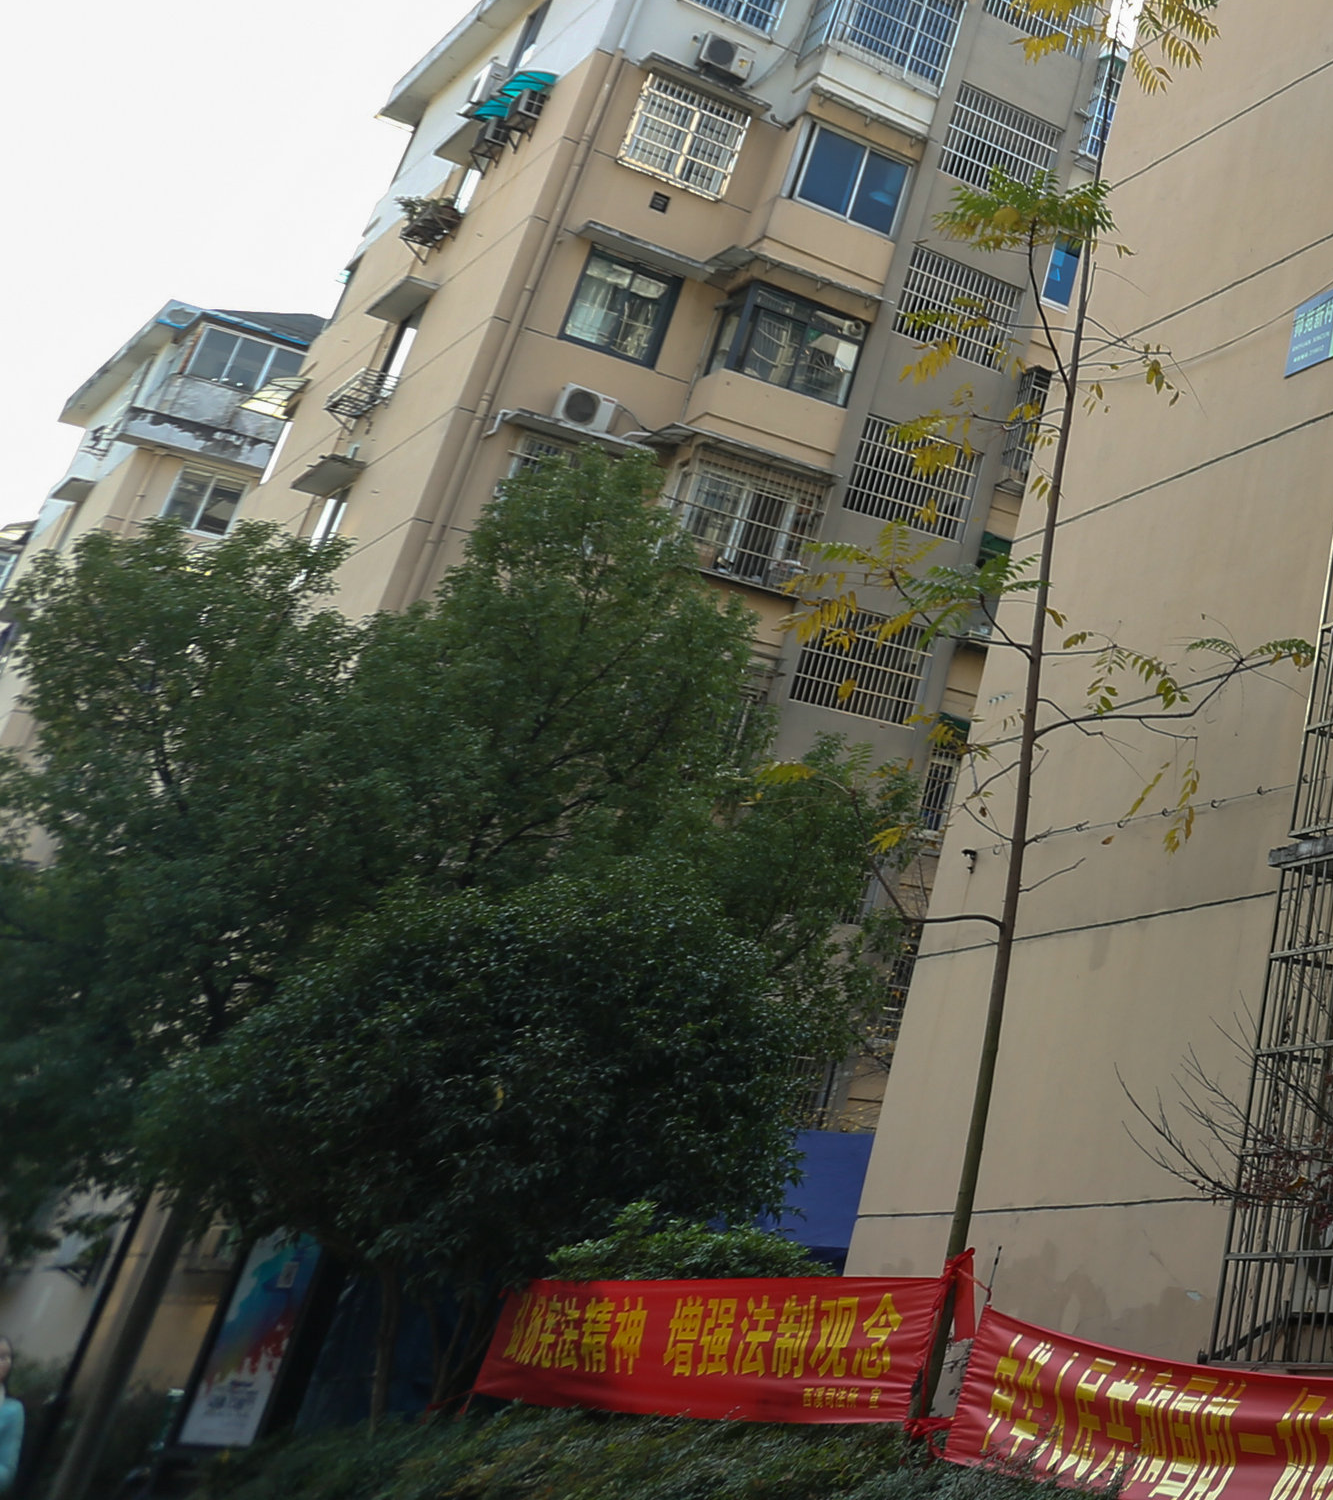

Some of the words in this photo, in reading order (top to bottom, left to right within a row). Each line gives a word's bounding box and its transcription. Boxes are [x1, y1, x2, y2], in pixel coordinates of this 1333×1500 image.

[502, 1293, 648, 1375] 弘扬宪法精神
[663, 1293, 903, 1378] 增强法制观念
[803, 1387, 858, 1408] 西溪司法所
